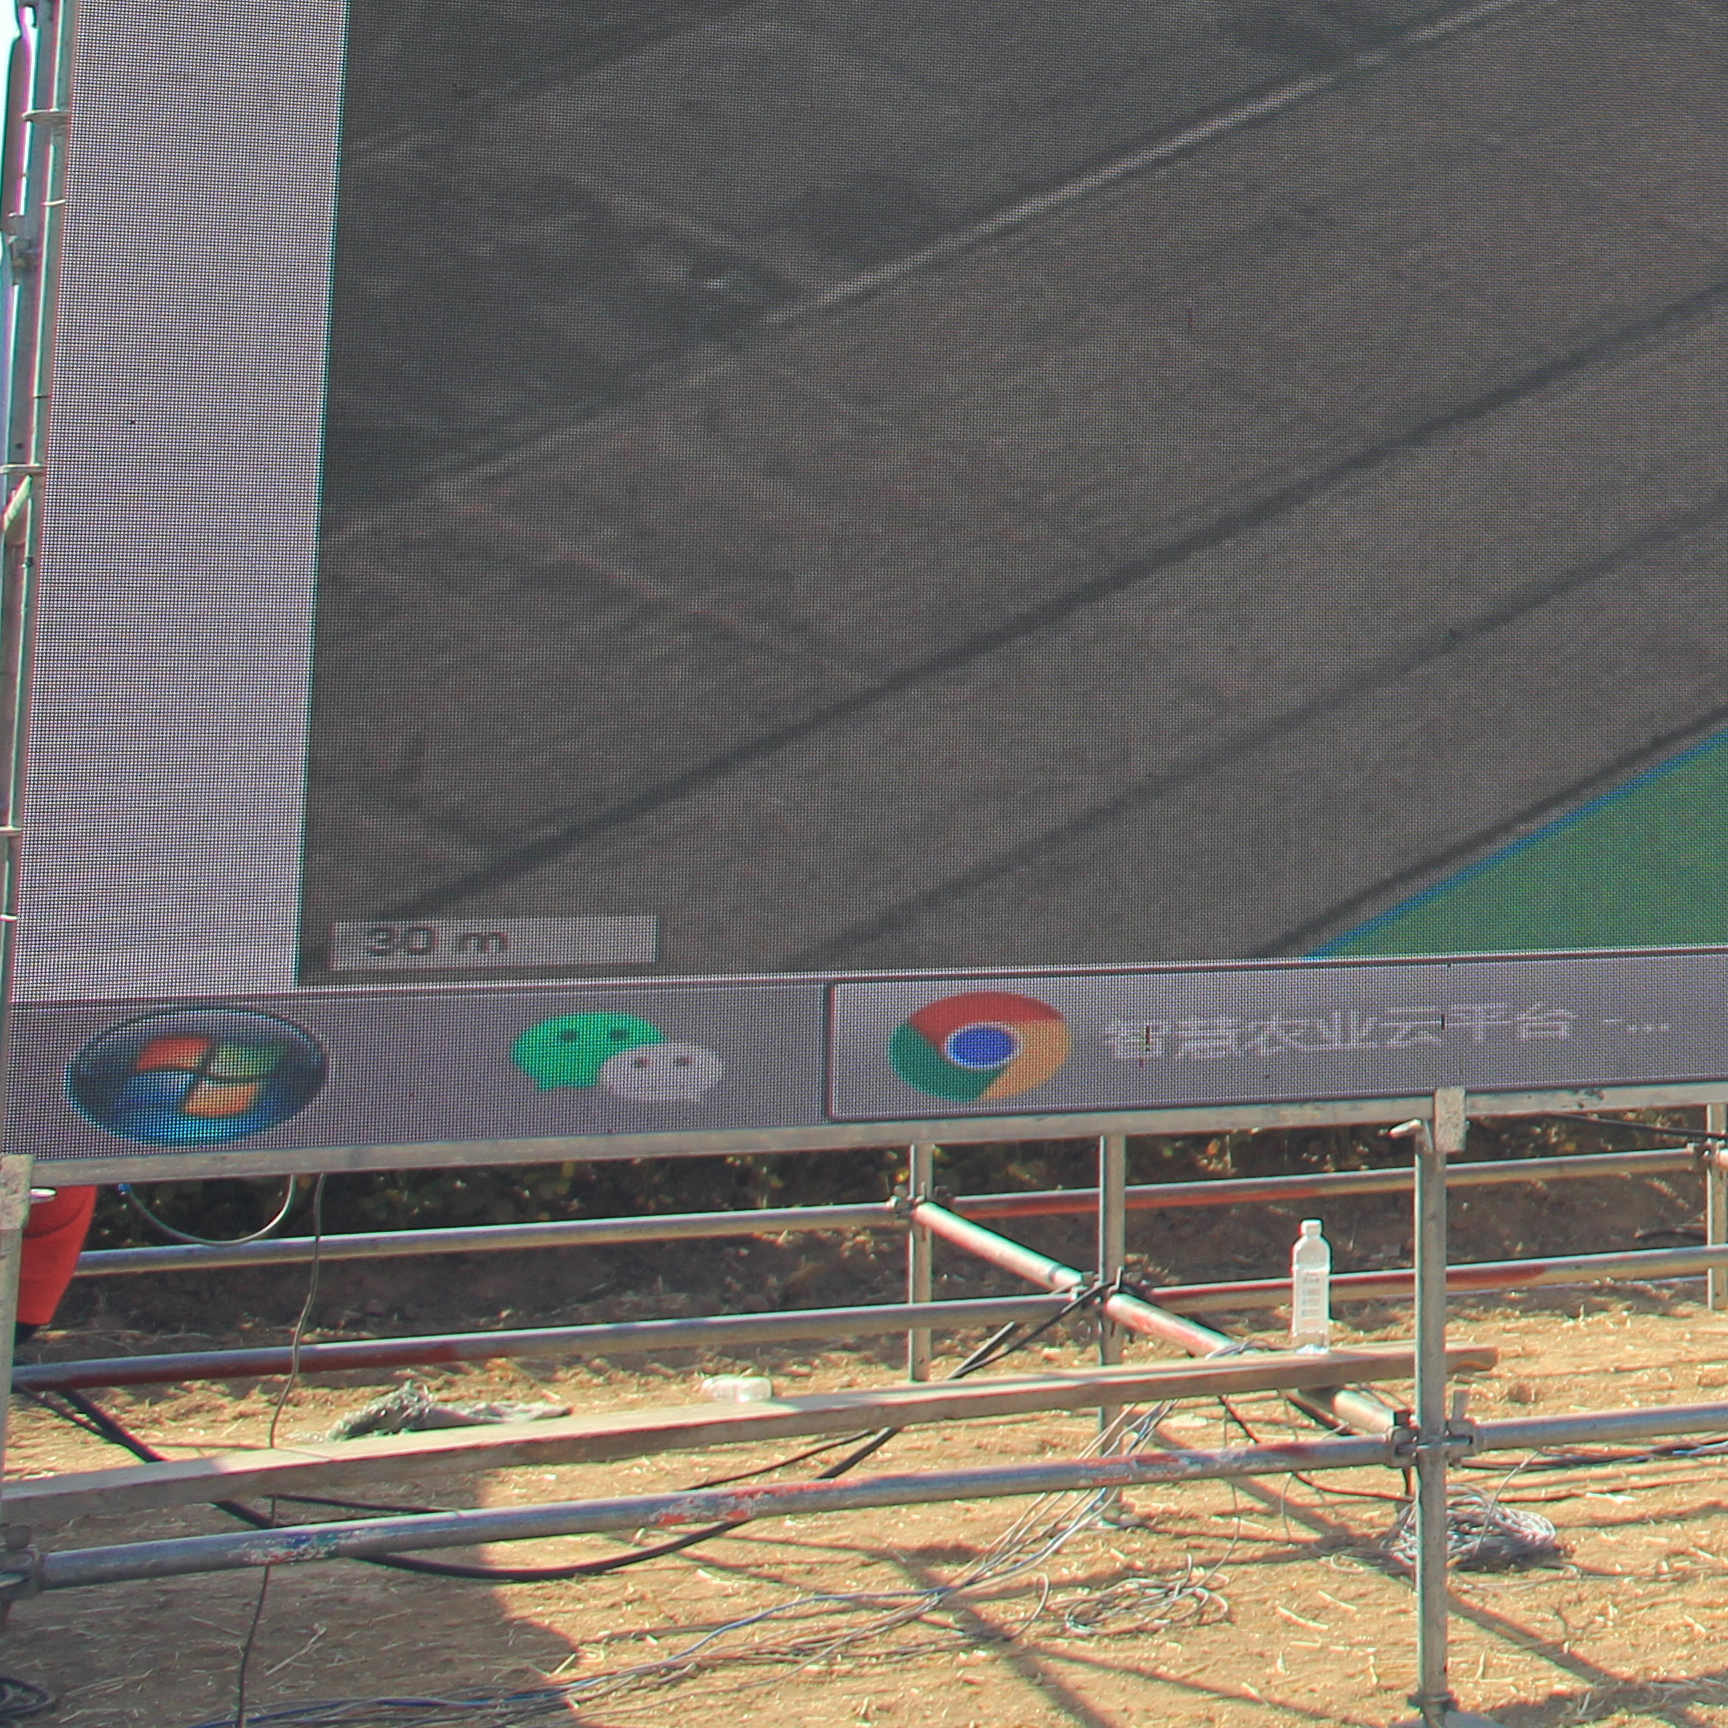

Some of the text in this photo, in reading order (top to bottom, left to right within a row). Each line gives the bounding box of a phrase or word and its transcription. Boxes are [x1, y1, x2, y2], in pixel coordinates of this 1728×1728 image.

[365, 925, 509, 959] 30 m
[1104, 1005, 1580, 1064] 智慧农业云平台
